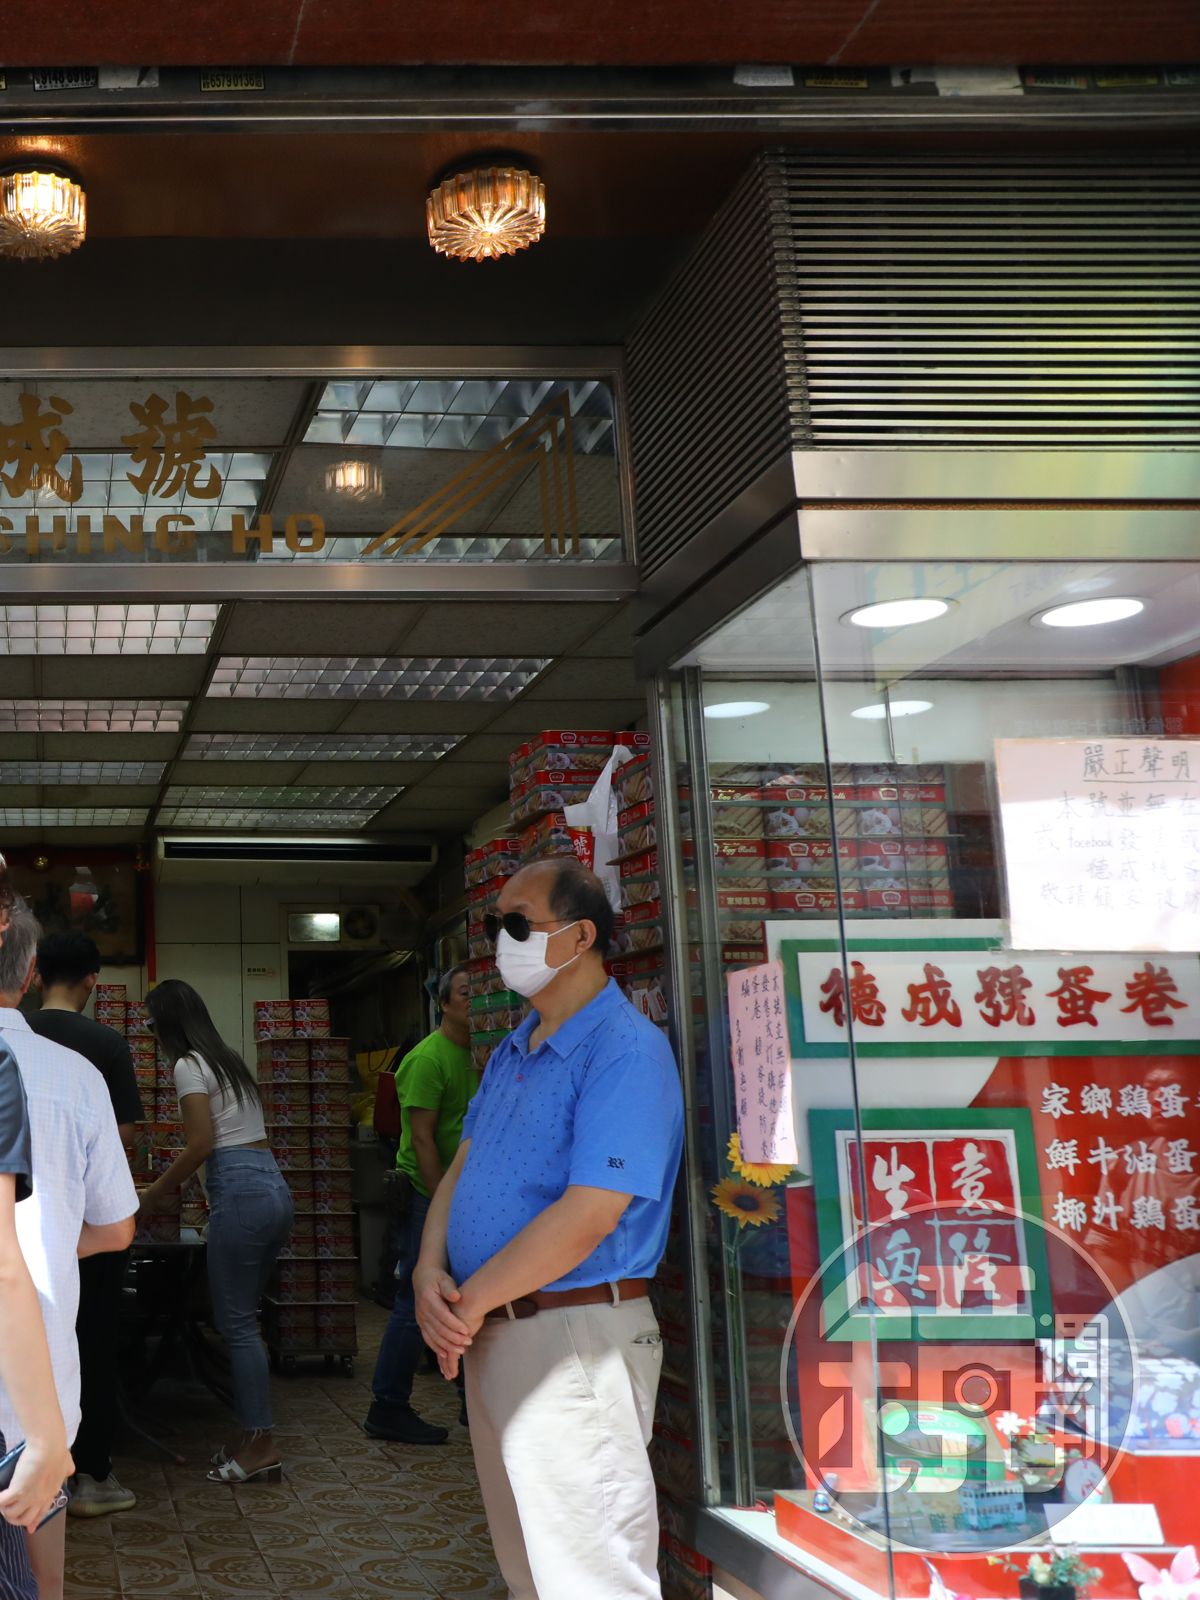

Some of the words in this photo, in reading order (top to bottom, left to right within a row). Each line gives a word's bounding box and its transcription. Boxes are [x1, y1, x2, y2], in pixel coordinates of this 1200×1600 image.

[231, 513, 325, 554] HO
[1083, 744, 1191, 779] 嚴正聲明
[819, 960, 1189, 1028] 德成號蛋卷
